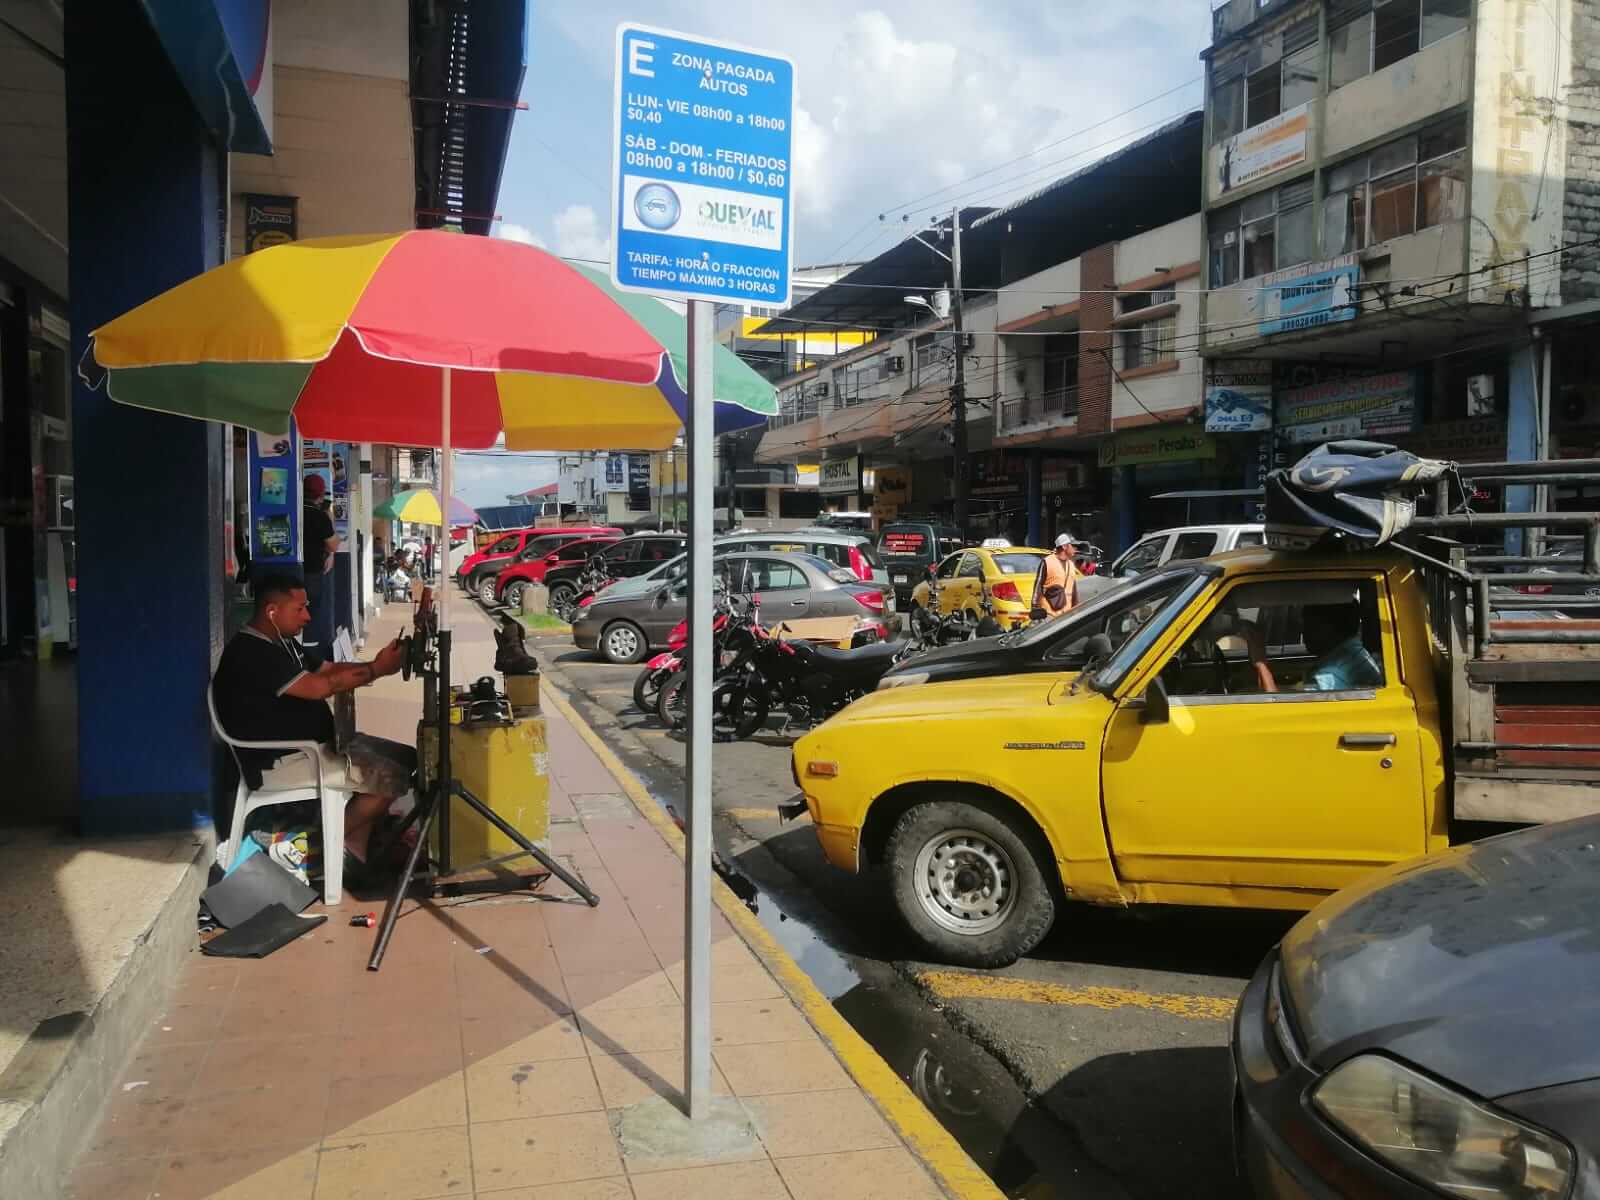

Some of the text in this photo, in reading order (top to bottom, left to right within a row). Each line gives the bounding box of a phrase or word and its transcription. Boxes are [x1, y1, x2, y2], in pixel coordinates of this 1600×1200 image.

[629, 38, 656, 78] E
[671, 53, 775, 84] ZONA PAGADA
[699, 78, 748, 97] AUTOS
[627, 107, 662, 124] $0,40
[628, 92, 785, 131] LUN- VIE 08h00 a 18h00
[625, 133, 656, 151] SÁB
[669, 141, 703, 158] DOM
[716, 149, 787, 172] FERIADOS
[626, 151, 673, 170] 08h00
[676, 162, 686, 173] a
[691, 161, 735, 180] 18h00
[747, 169, 784, 188] $0,60
[698, 201, 776, 231] QUEVIAL
[627, 251, 780, 281] TARIFA: HORA O FRACCIÓN
[631, 267, 776, 294] TIEMPO MÁXIMO 3 HORAS
[824, 462, 851, 480] HOSTAL
